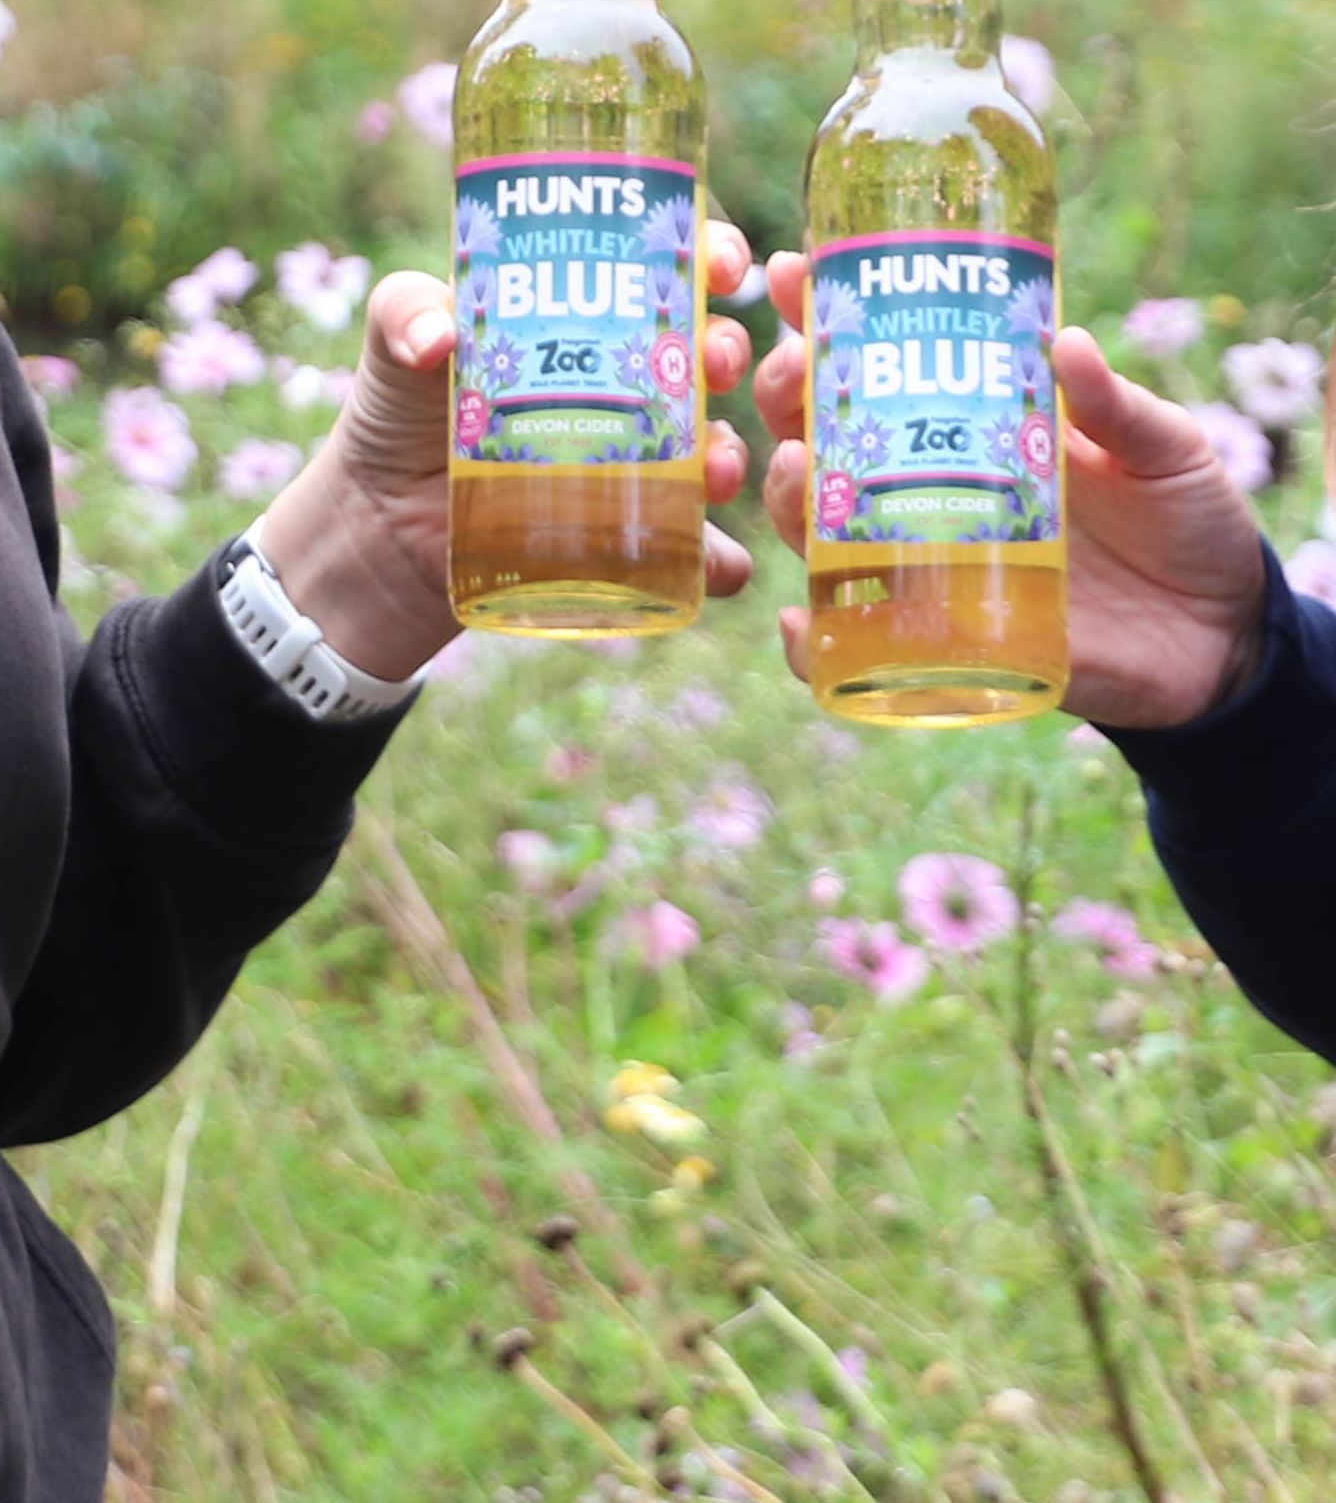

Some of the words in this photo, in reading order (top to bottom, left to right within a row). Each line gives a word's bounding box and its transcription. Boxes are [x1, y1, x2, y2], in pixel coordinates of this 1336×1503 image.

[496, 175, 647, 219] HUNTS
[506, 228, 637, 260] WHITLEY
[497, 260, 647, 319] BLUE
[859, 254, 1012, 298] HUNTS
[870, 306, 1004, 339] WHITLEY
[862, 339, 1014, 399] BLUE
[511, 418, 570, 434] DEVON
[573, 418, 625, 434] CIDER
[880, 497, 943, 514] DEVON
[945, 497, 996, 514] CIDER
